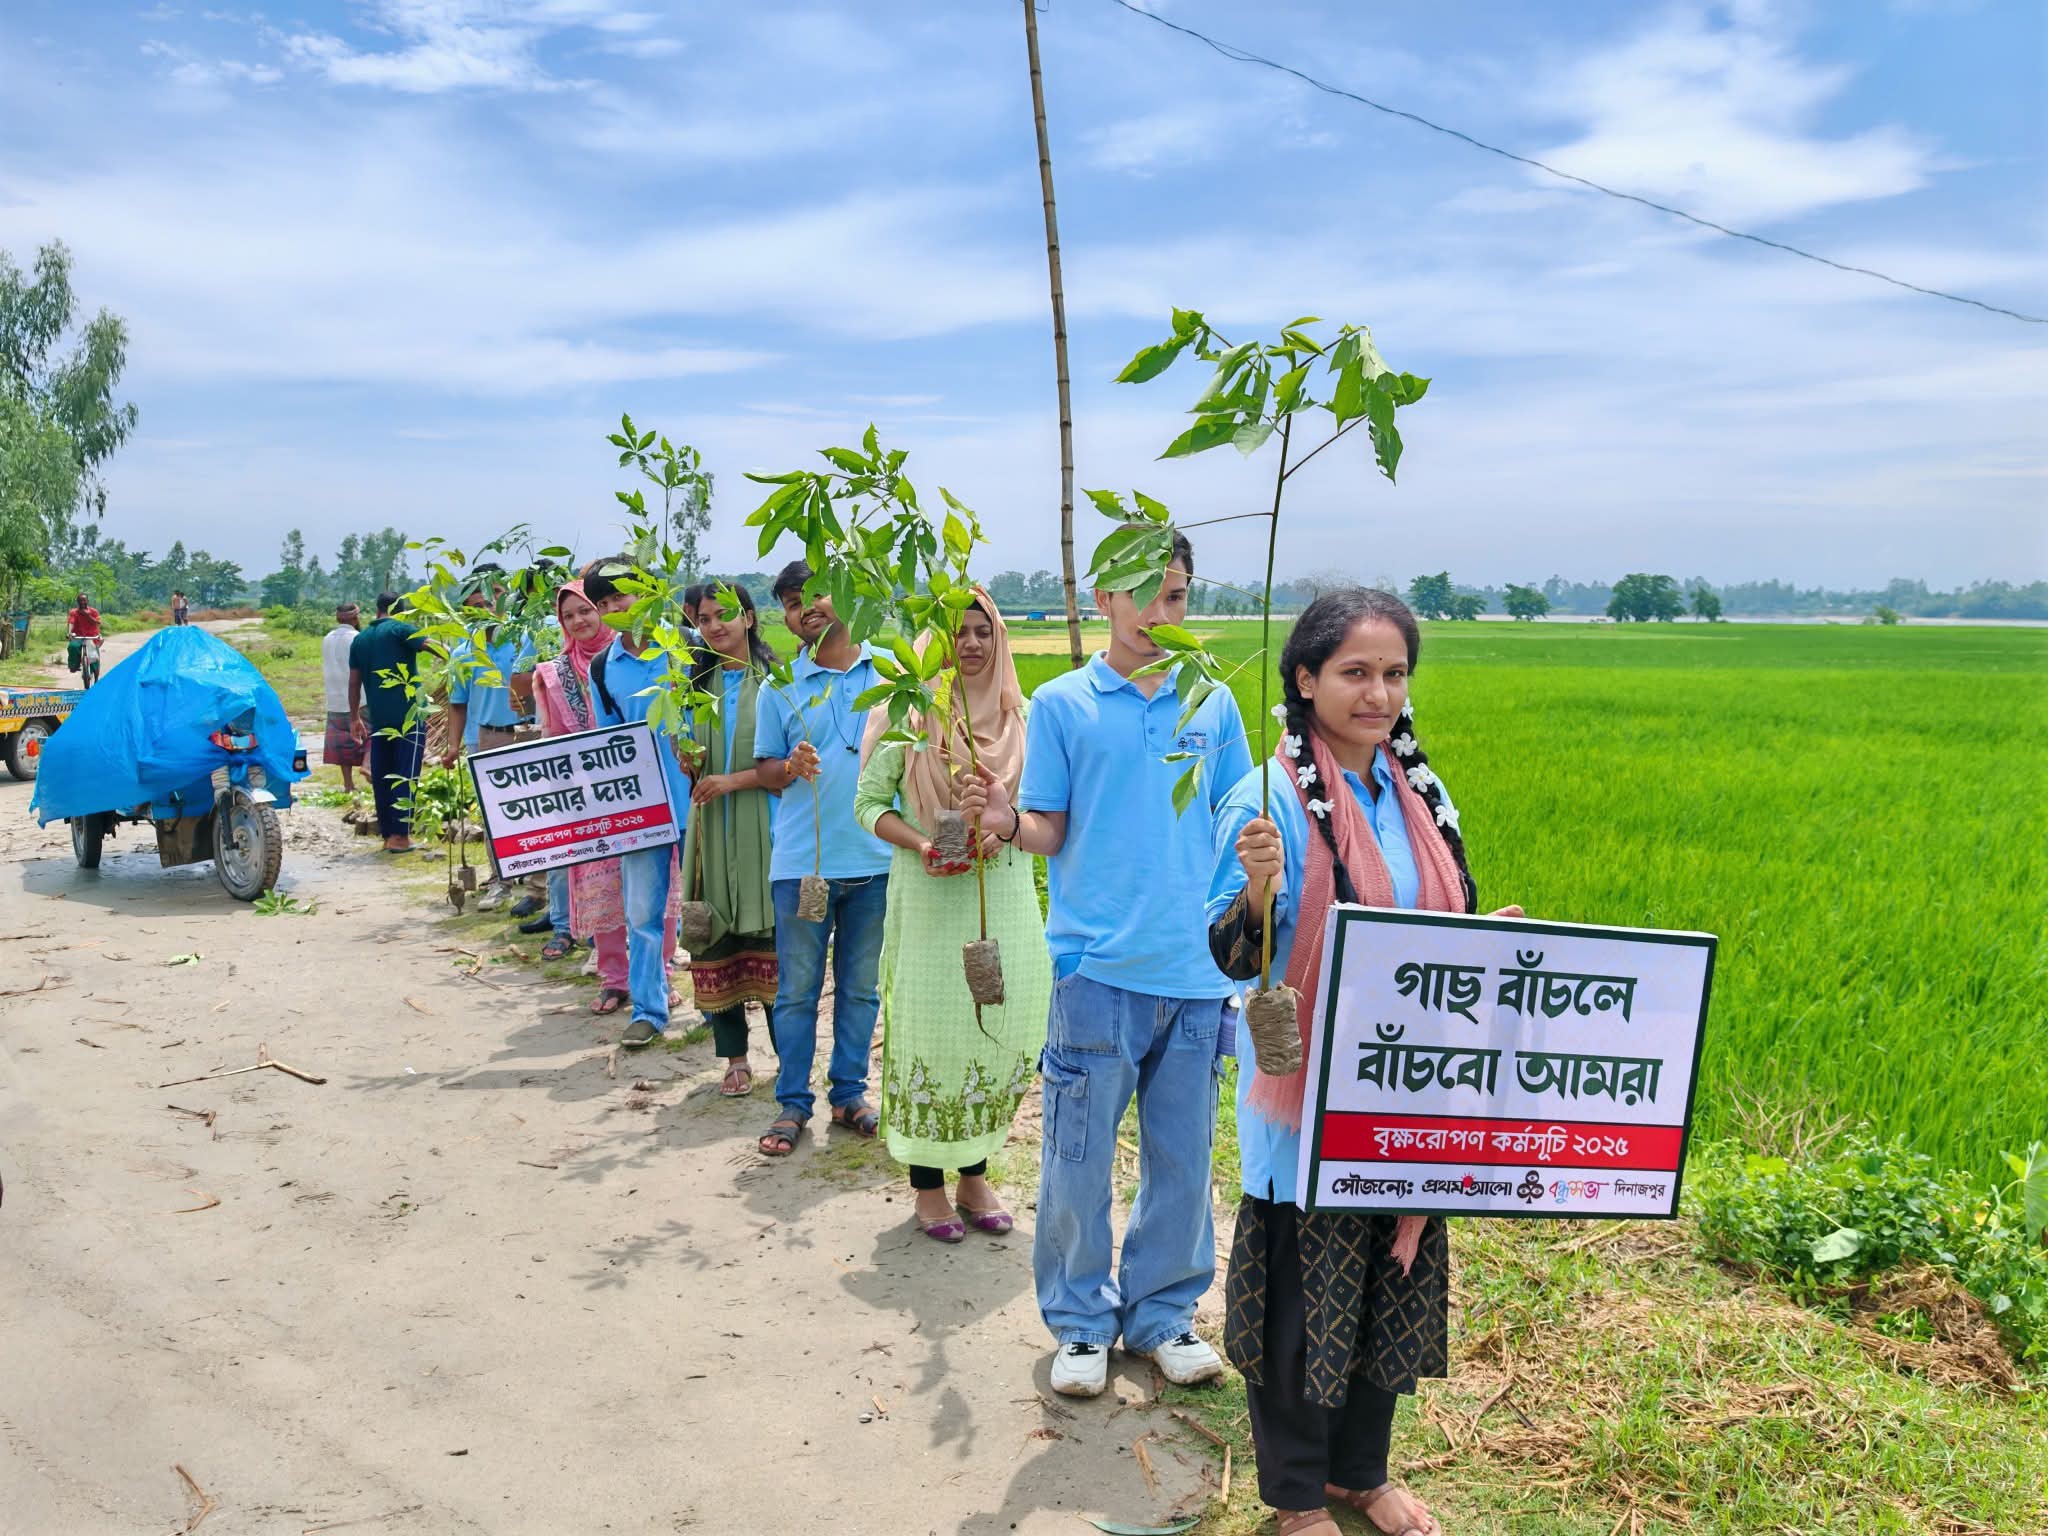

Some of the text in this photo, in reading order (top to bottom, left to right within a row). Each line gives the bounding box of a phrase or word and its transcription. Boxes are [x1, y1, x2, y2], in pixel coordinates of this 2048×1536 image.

[486, 735, 637, 788] আমার মাটি
[499, 775, 642, 820] আমার দায়
[517, 830, 573, 850] বৃক্ষরোপণ
[615, 816, 644, 828] ২০২৫
[1394, 949, 1638, 1024] গাছ বাঁচলে
[1357, 1023, 1664, 1106] বাঁচবো আমরা
[1373, 1125, 1630, 1161] বৃক্ষরোপণ কর্মসূচি ২০২৫
[1613, 1178, 1667, 1201] দিনাজপুর
